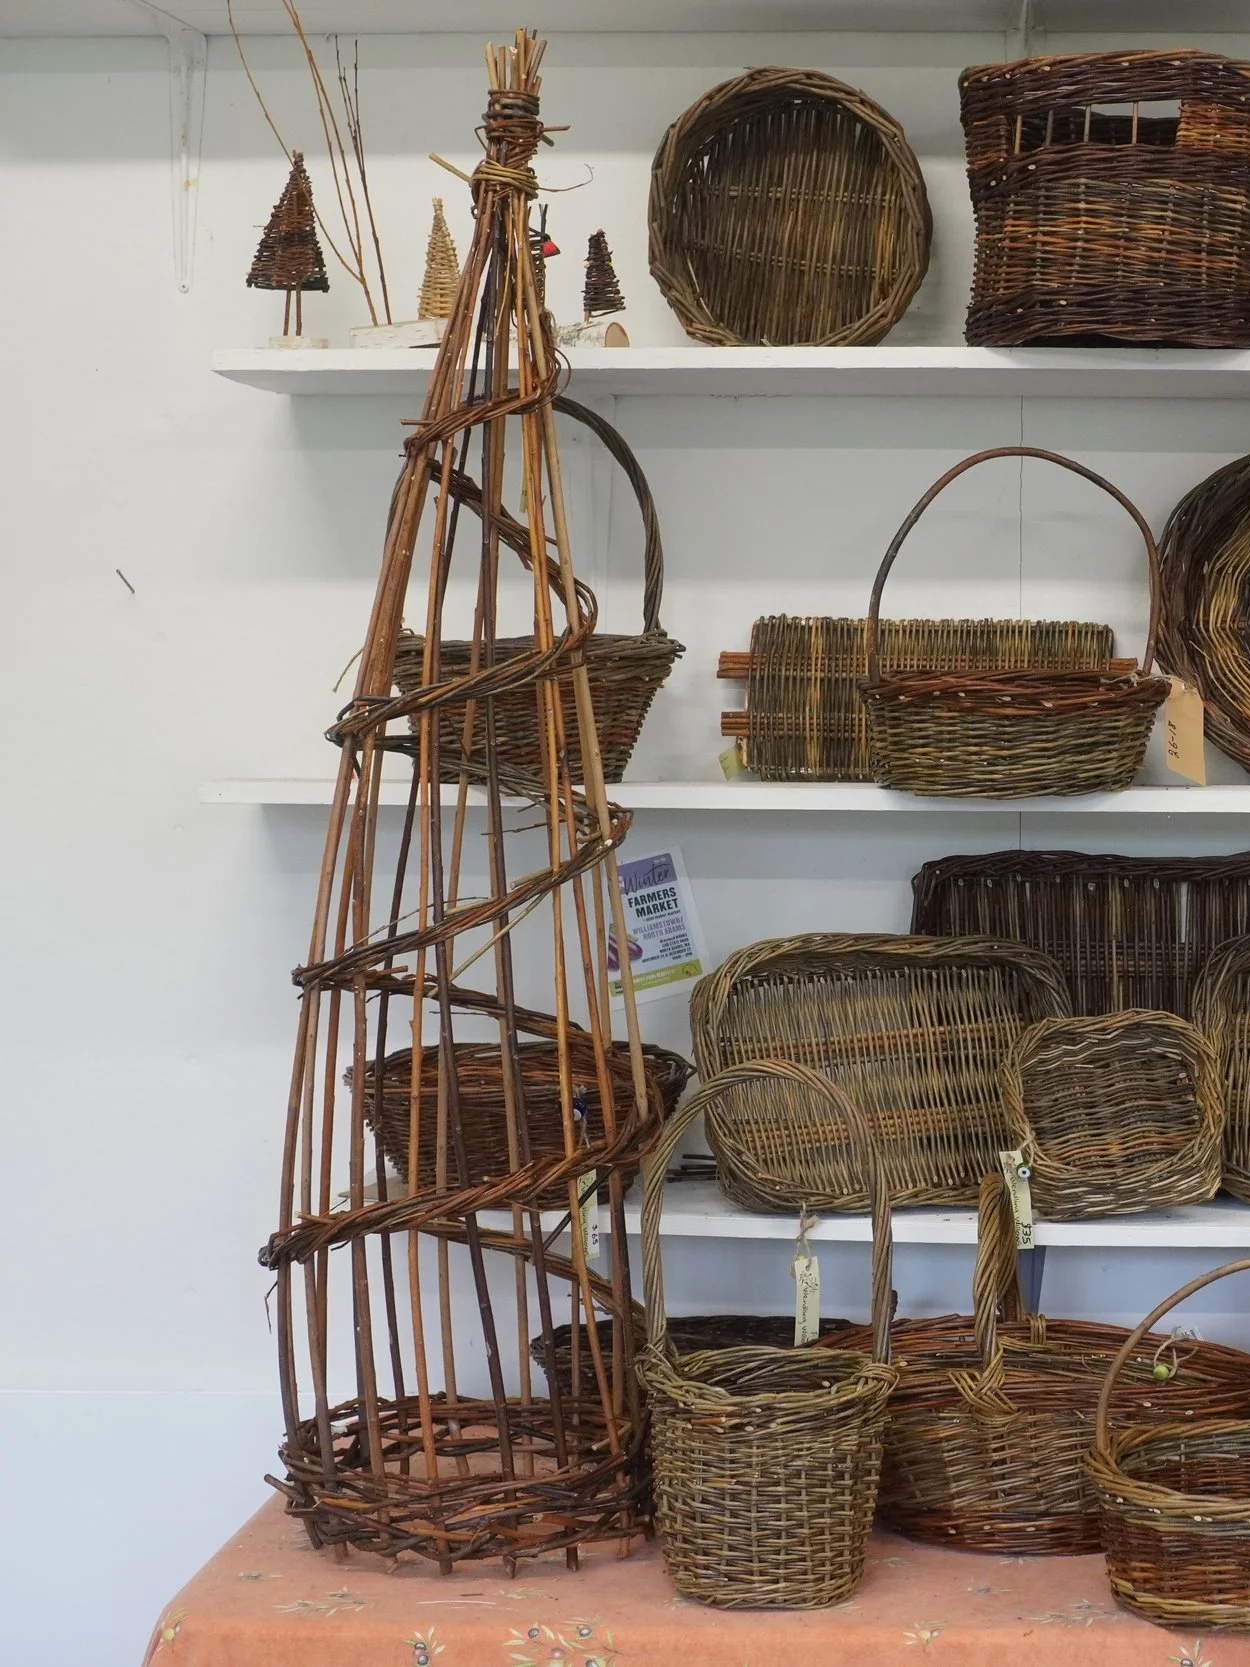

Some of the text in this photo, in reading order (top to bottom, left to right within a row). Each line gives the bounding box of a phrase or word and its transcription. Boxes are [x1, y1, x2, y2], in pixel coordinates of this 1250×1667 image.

[623, 862, 670, 896] Winter
[628, 887, 676, 908] FARMERS
[635, 898, 678, 918] MARKET
[664, 923, 686, 935] ADAMS
[1019, 1221, 1032, 1245] $35
